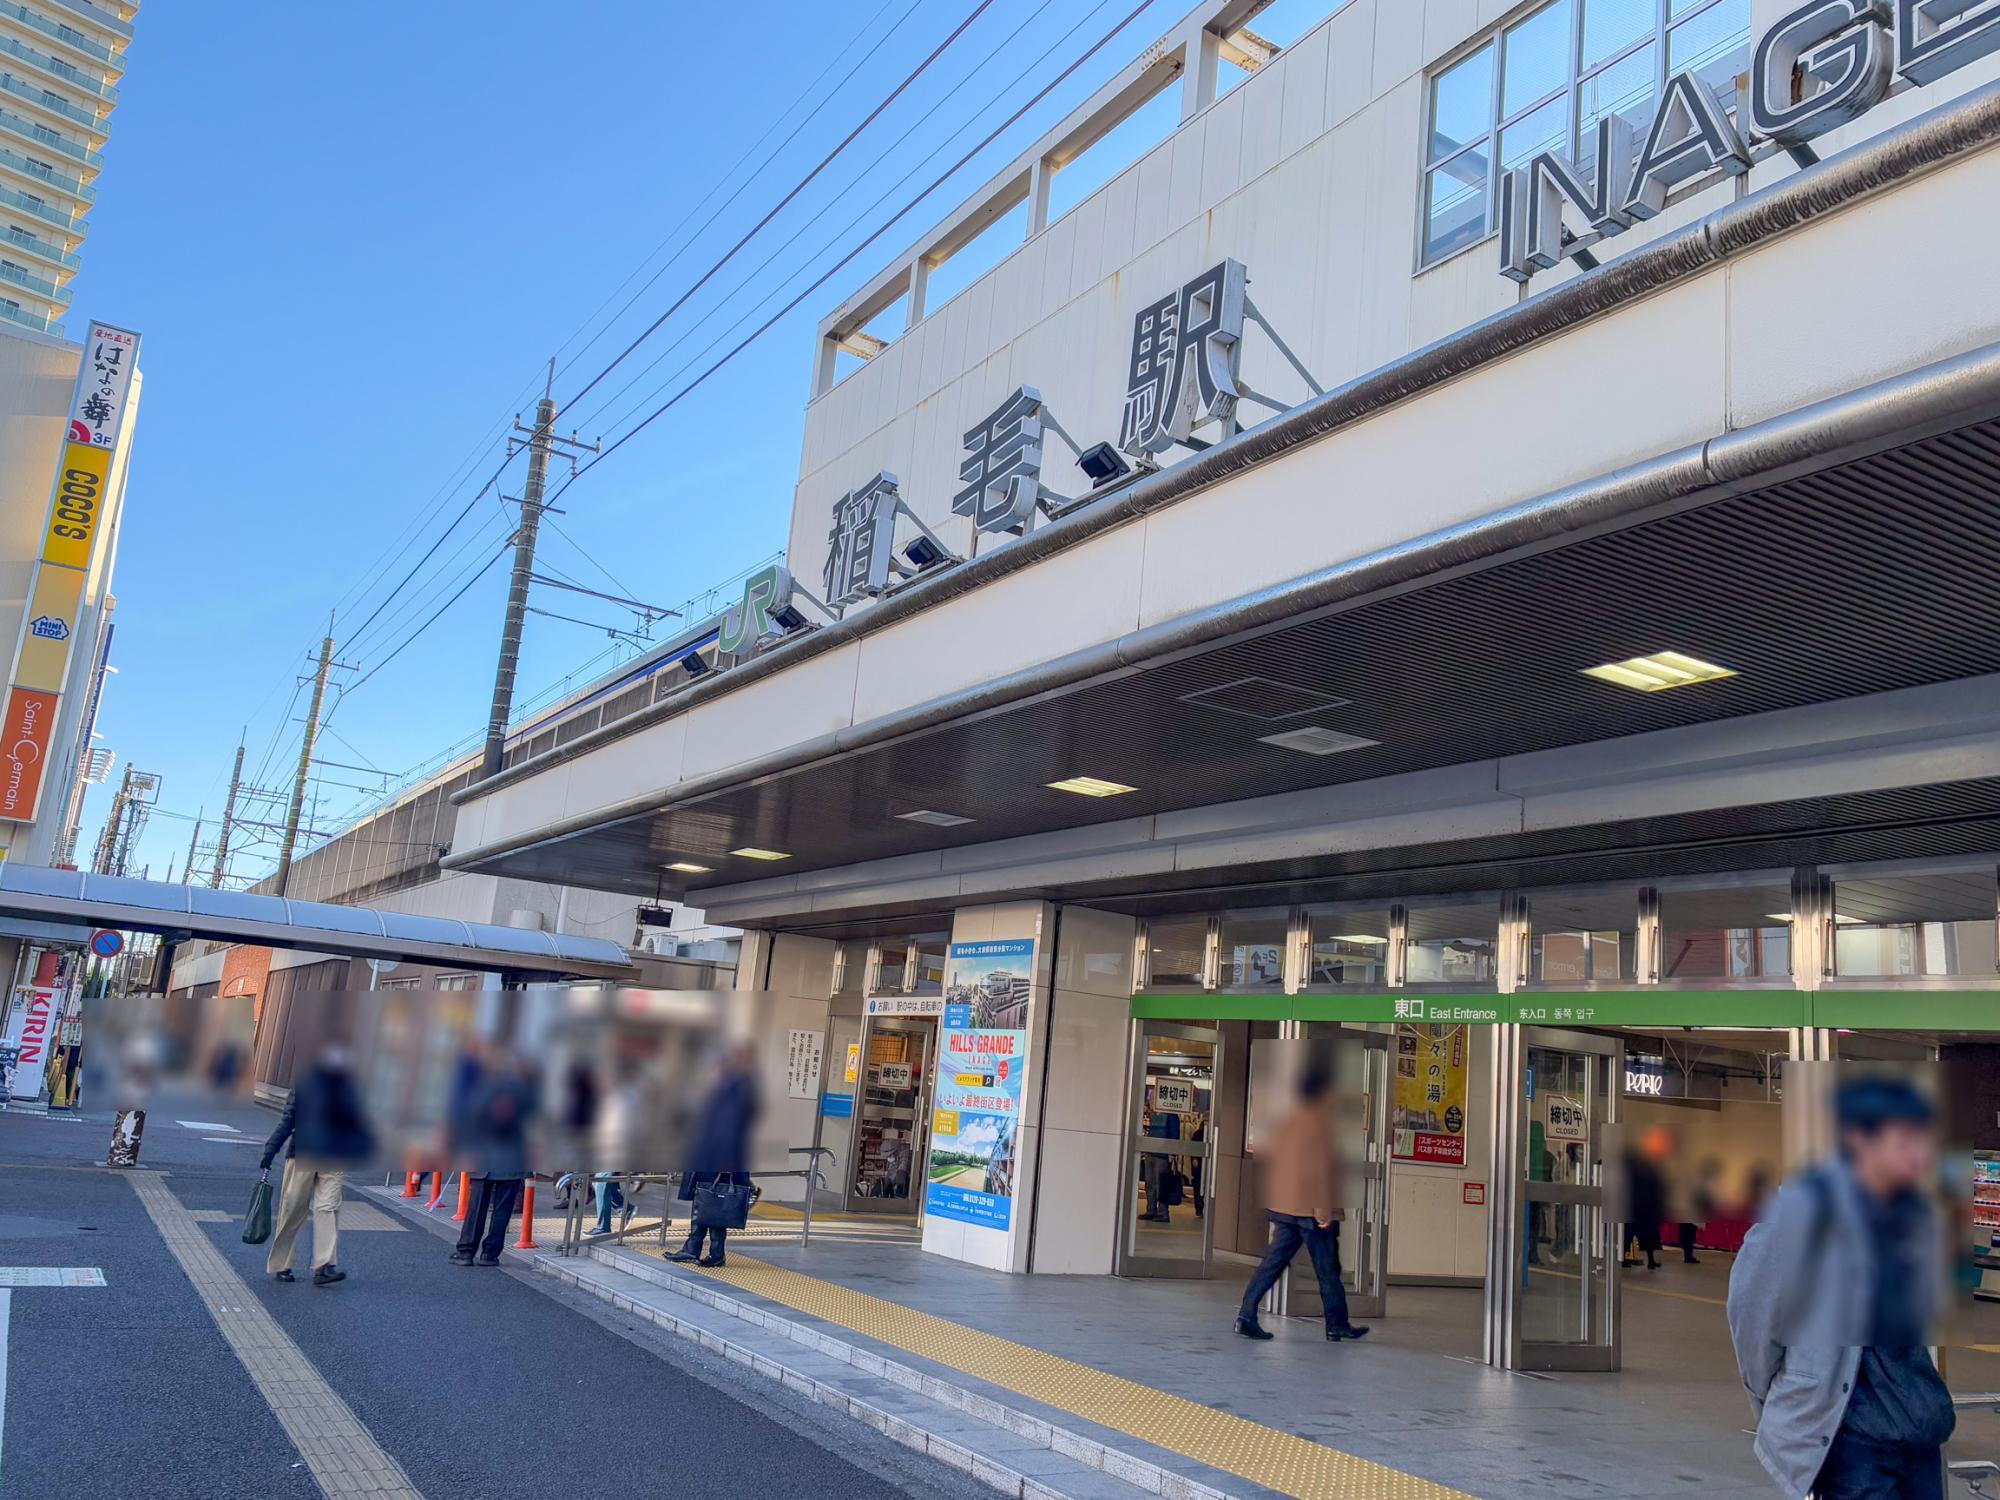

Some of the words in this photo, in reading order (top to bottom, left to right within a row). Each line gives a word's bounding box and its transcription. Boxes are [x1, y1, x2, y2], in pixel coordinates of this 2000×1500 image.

[94, 328, 133, 347] 産地直送
[92, 431, 112, 446] 3F
[718, 565, 791, 656] JR
[823, 258, 1246, 607] 稲毛駅
[53, 468, 99, 541] COCO'S
[37, 627, 62, 637] STOP
[40, 620, 62, 630] MINI
[1394, 998, 1424, 1019] 東口
[1430, 1007, 1451, 1019] East
[1454, 1007, 1497, 1020] Entrance
[1576, 1008, 1596, 1020] 입구
[19, 992, 53, 1064] KIRIN
[950, 1034, 975, 1053] HILLS
[977, 1035, 1015, 1055] GRANDE
[1159, 1085, 1188, 1102] 締切中
[1550, 1105, 1583, 1127] 締切中
[1556, 1127, 1579, 1135] CLOSED
